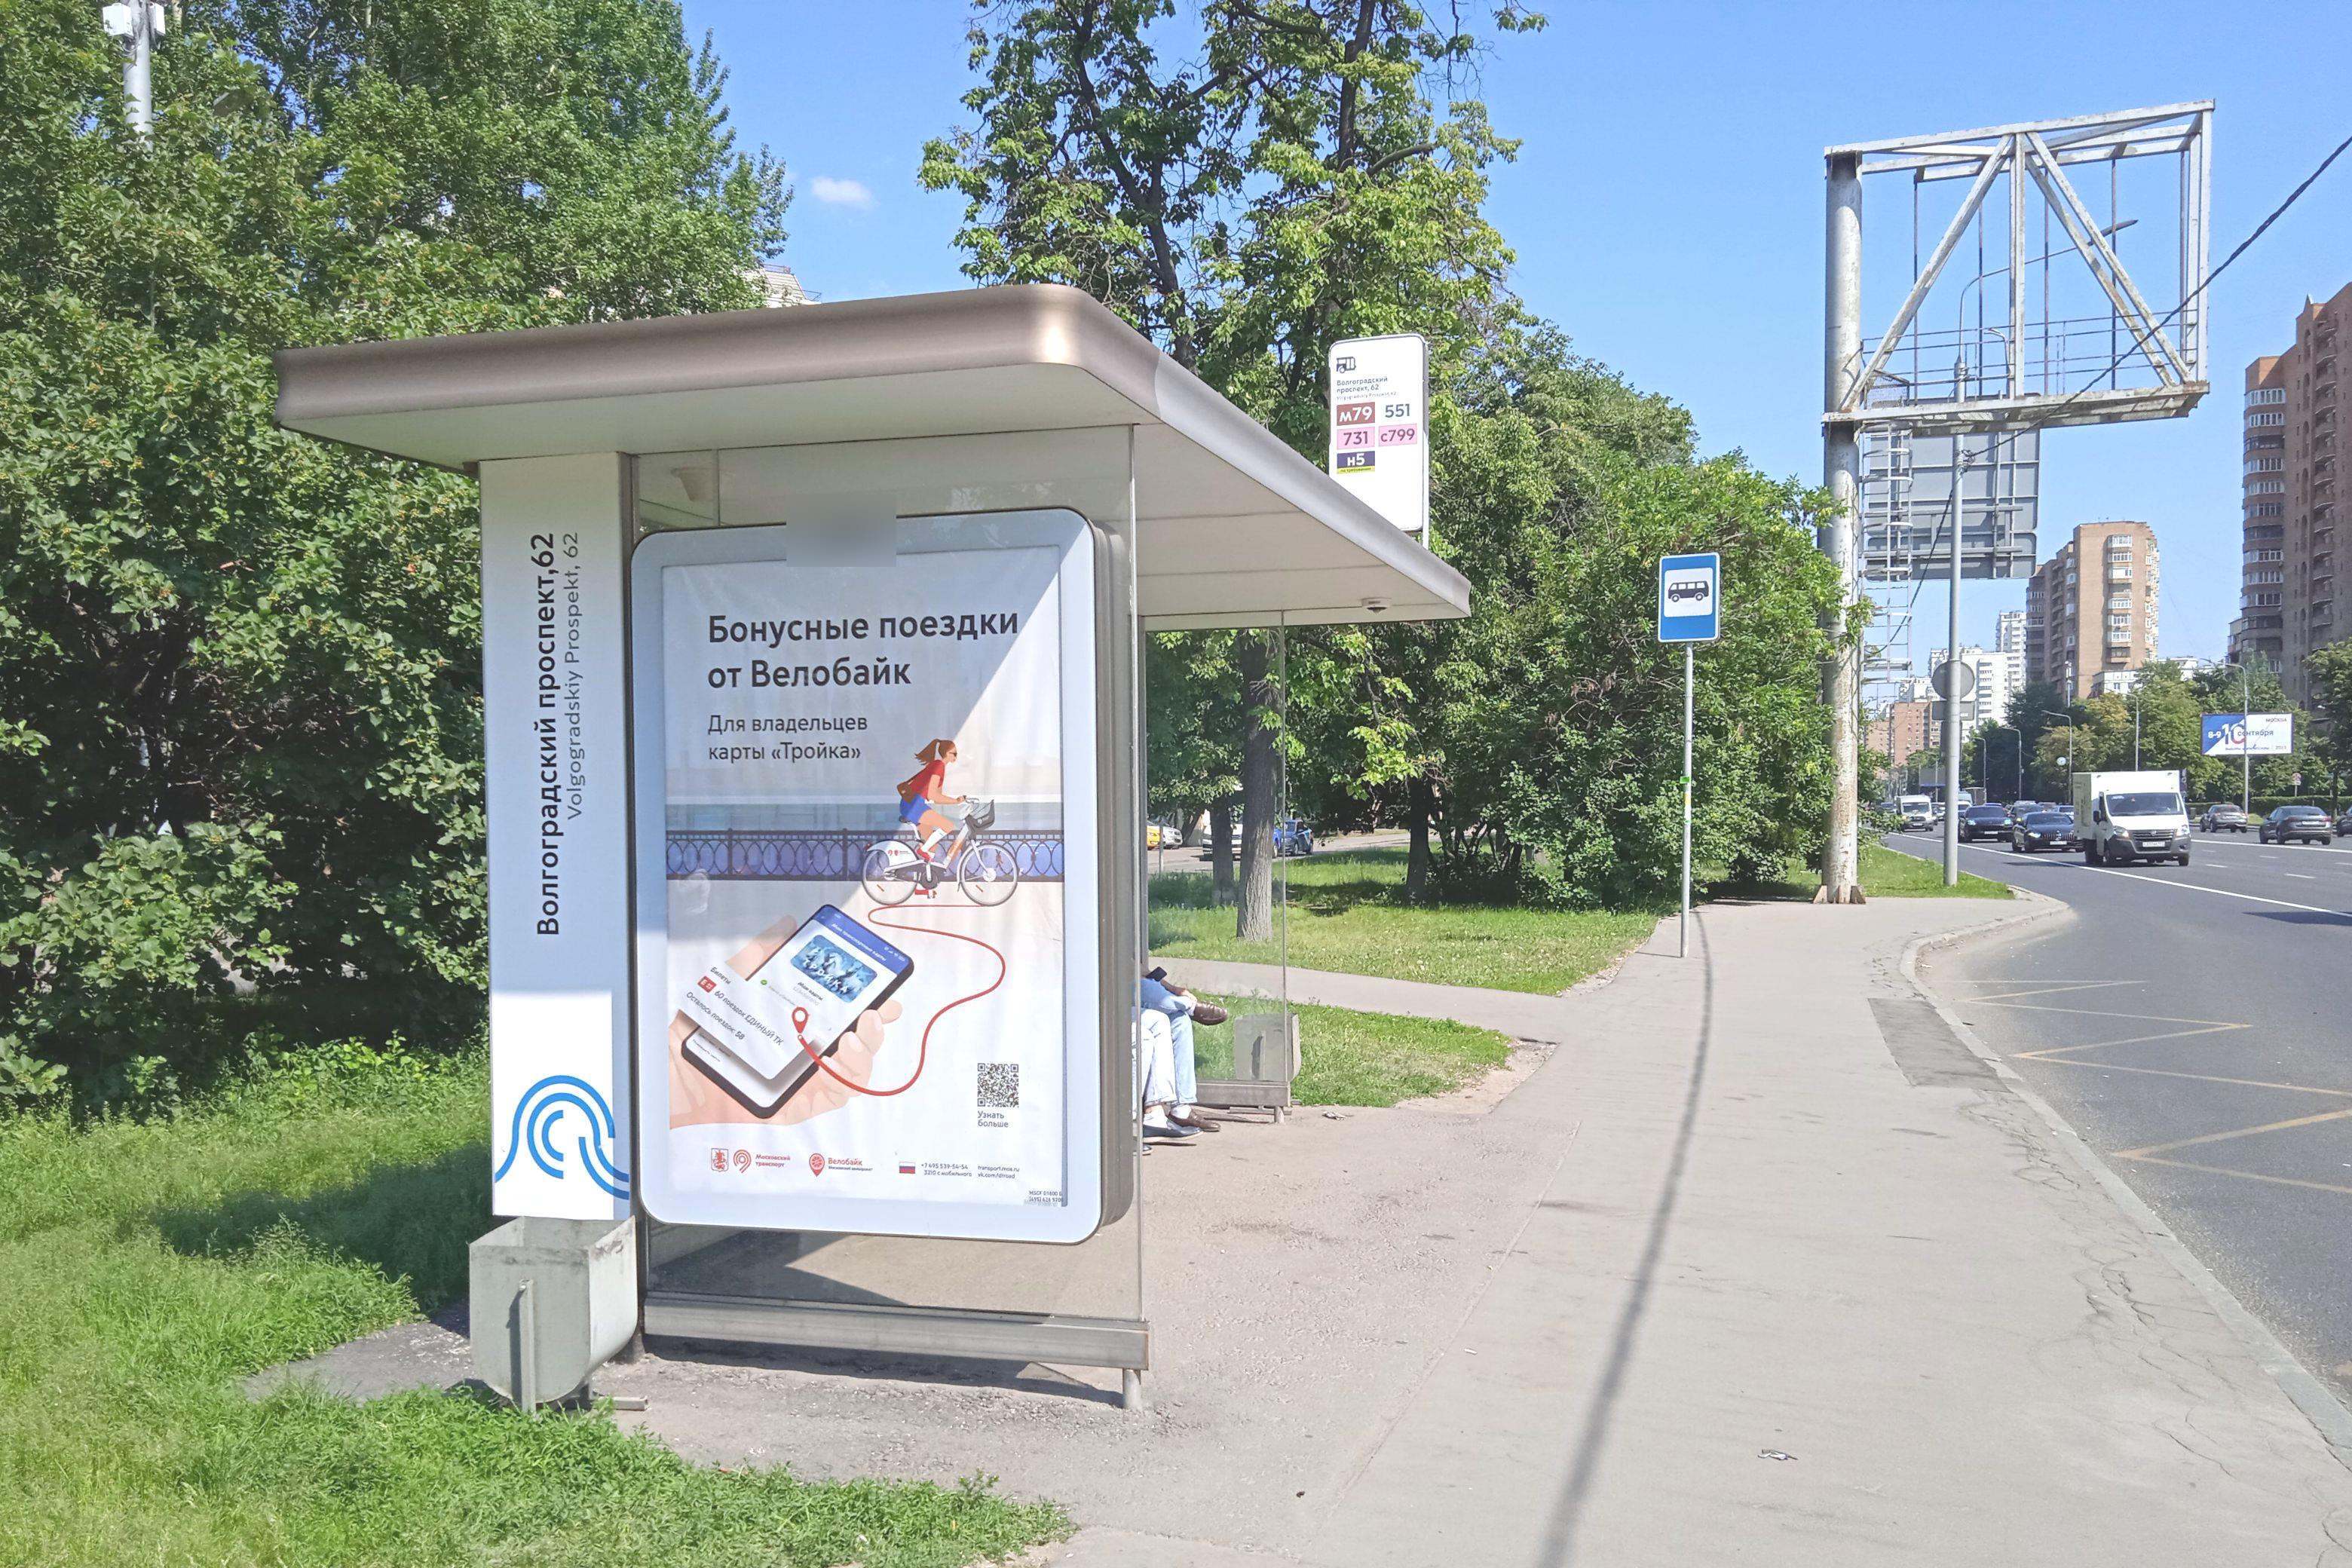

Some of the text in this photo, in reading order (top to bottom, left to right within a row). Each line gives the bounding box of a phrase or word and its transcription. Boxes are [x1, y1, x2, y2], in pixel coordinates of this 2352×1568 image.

[1337, 377, 1388, 386] Волгоградский
[1339, 406, 1373, 422] м79
[1385, 403, 1410, 418] 551
[1343, 430, 1368, 446] 731
[1380, 428, 1415, 443] с799
[1347, 453, 1365, 466] н5
[709, 612, 1018, 649] Бонусные поездки
[563, 532, 586, 820] Volgogradskiy Prospekt, 62
[708, 657, 911, 689] от Велобайк
[708, 714, 868, 735] Для владельцев
[709, 740, 861, 764] карты «Тройка»
[533, 718, 564, 935] Волгоградский
[710, 966, 731, 985] Билеты
[745, 1014, 775, 1039] ЕДИНЫЙ
[977, 1110, 1005, 1119] Узнать
[978, 1119, 1009, 1128] больше
[828, 1157, 863, 1166] Велобайк
